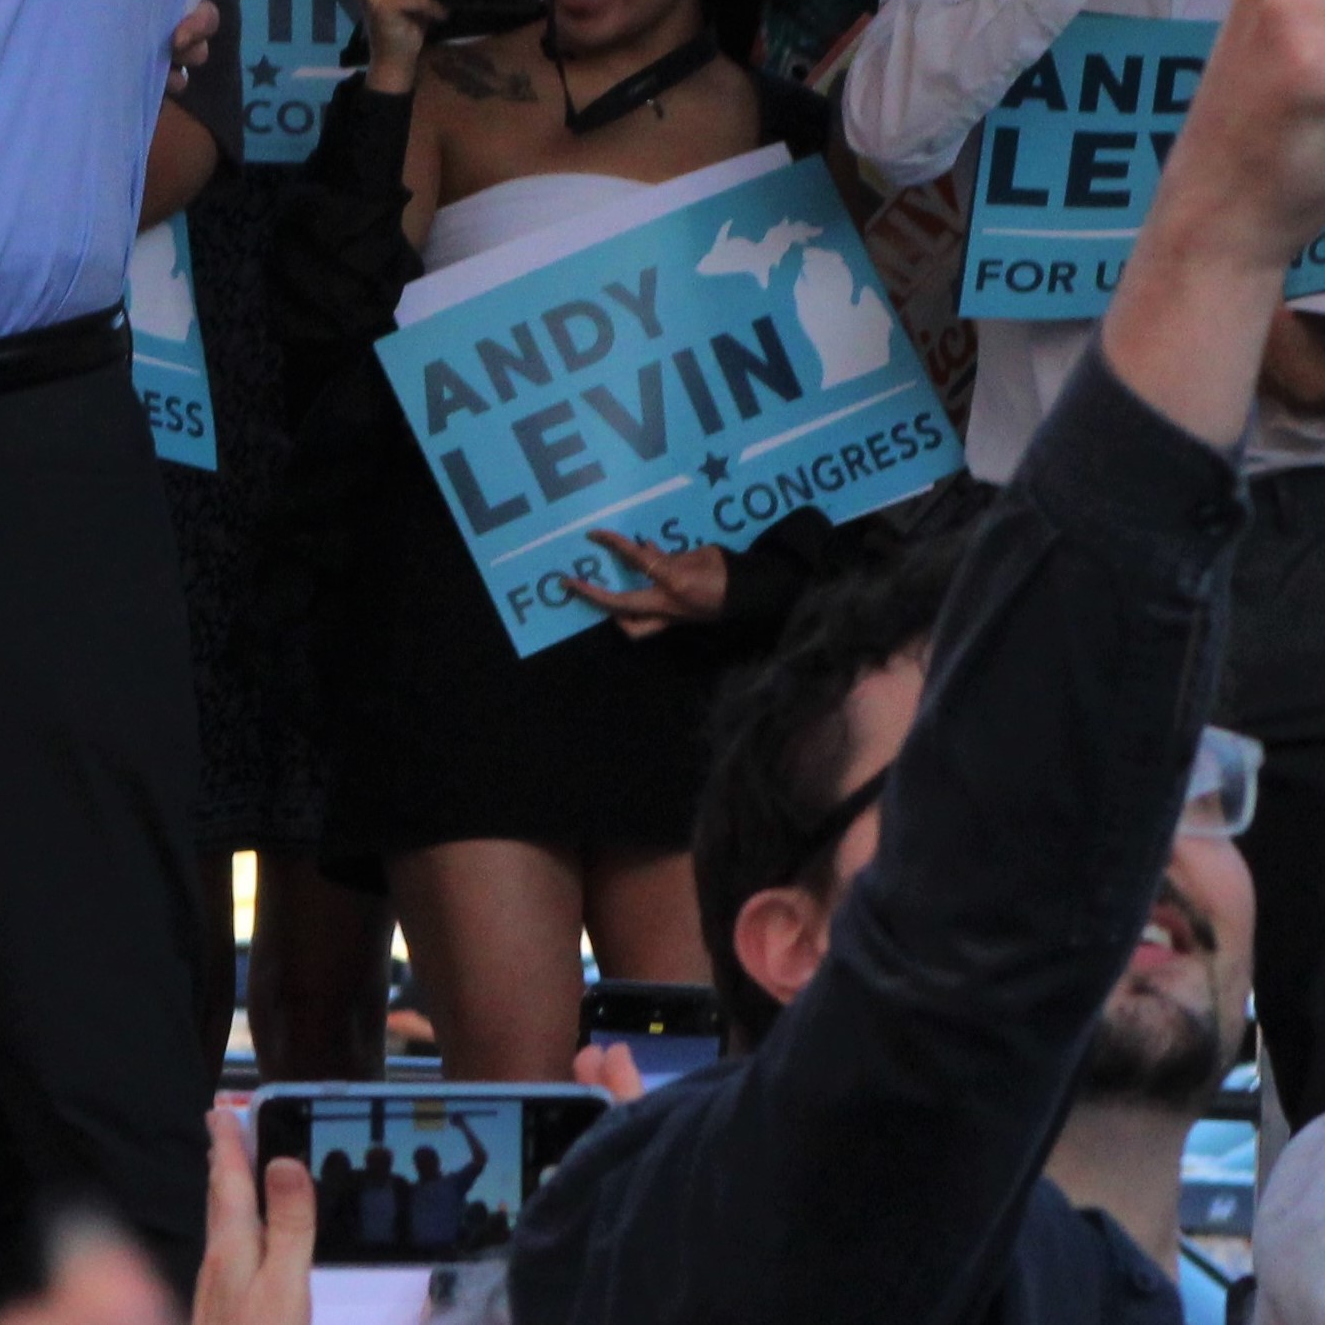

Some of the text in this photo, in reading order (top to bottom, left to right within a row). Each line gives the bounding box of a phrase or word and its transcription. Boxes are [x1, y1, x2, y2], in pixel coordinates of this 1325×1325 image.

[999, 51, 1207, 115] AND
[422, 266, 665, 436] ANDY
[975, 258, 1077, 295] FOR
[439, 315, 803, 536] LEVIN
[506, 555, 610, 625] FOR
[713, 411, 943, 533] CONGRESS
